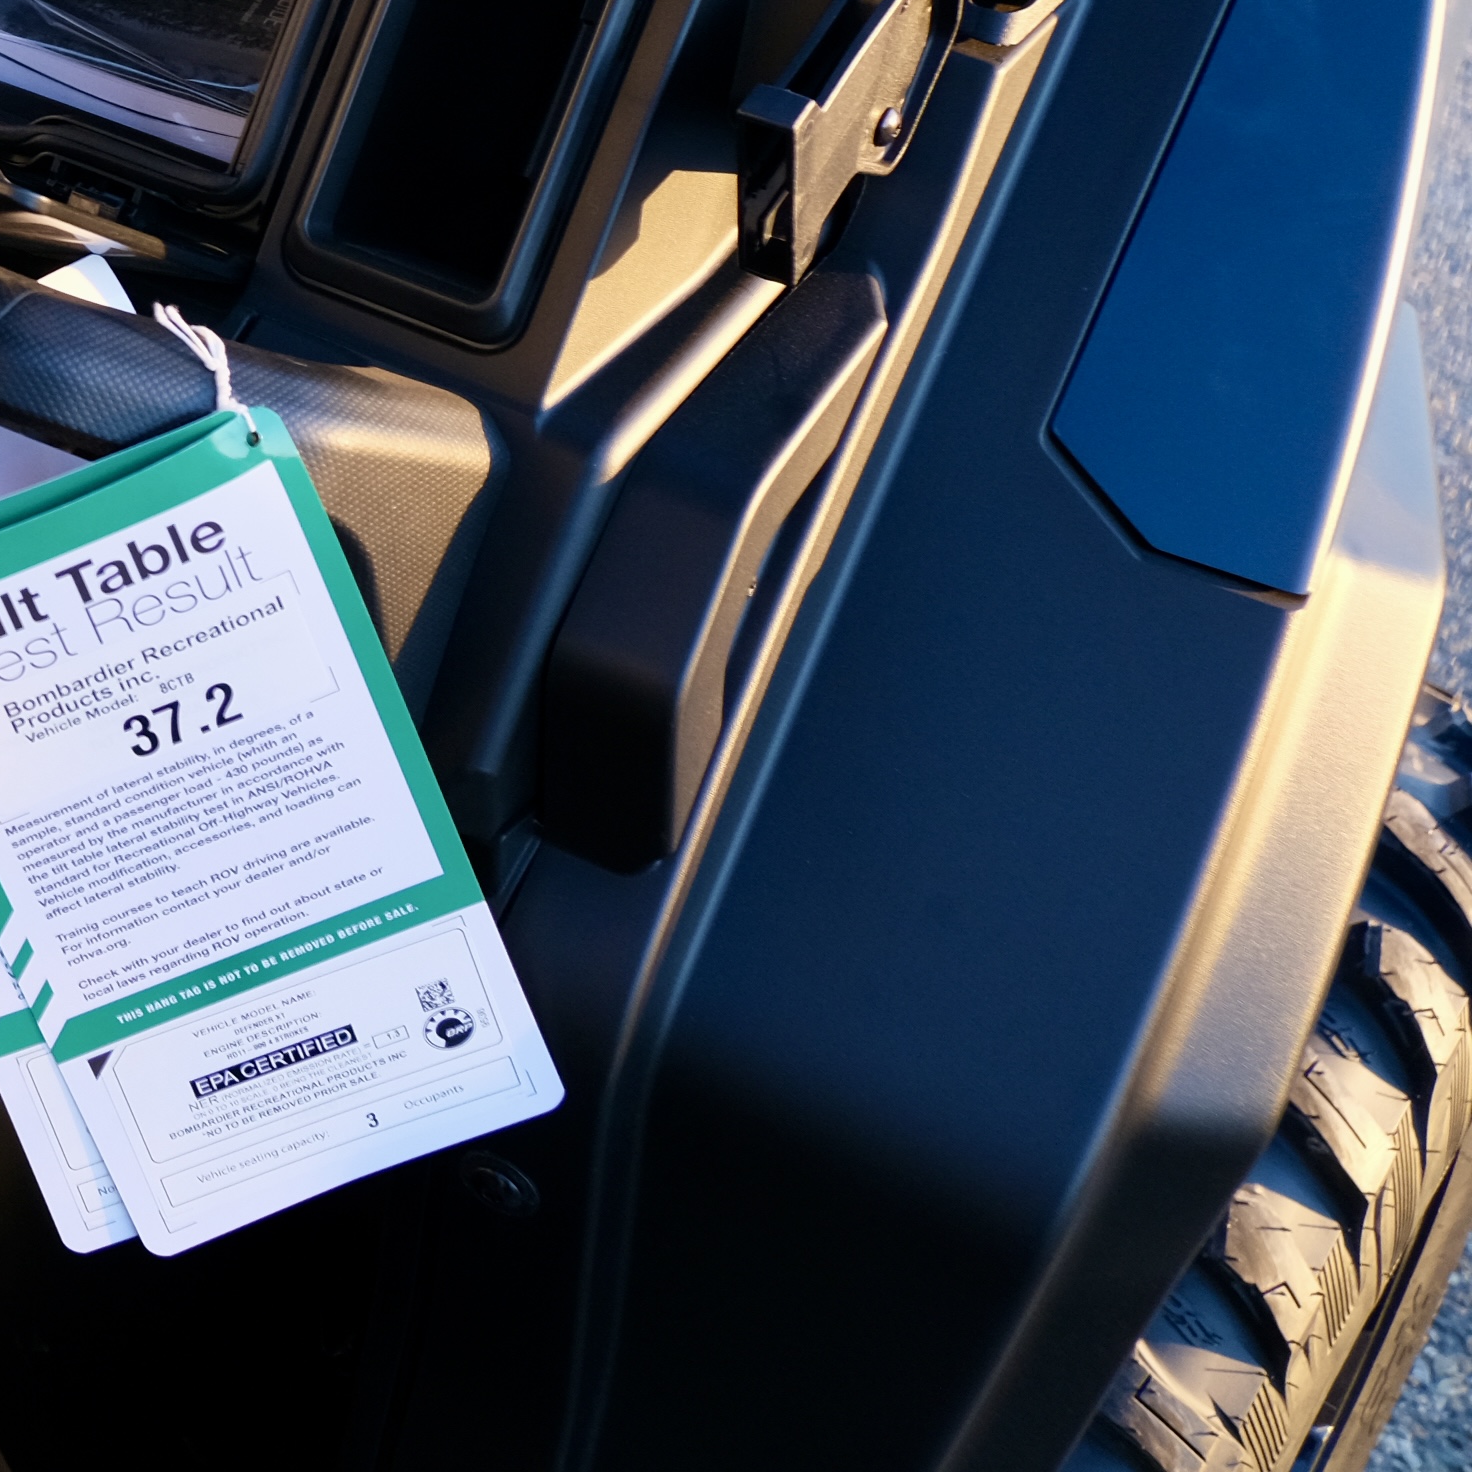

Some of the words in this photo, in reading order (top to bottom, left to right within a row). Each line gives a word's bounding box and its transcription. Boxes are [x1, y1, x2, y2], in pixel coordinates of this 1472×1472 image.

[54, 521, 228, 610] Table
[84, 546, 263, 645] Result
[3, 658, 134, 718] Bombardier
[141, 595, 284, 664] Recreational
[10, 687, 113, 734] Products
[117, 671, 160, 692] inc.
[25, 717, 81, 743] Vehicle
[85, 694, 138, 720] Model:
[159, 672, 195, 694] 8CTB
[123, 683, 243, 757] 37.2
[4, 796, 94, 837] Measurement
[96, 789, 109, 800] of
[111, 772, 154, 794] lateral
[156, 753, 211, 777] stability,
[212, 746, 226, 756] in
[229, 724, 286, 750] degrees,
[289, 713, 302, 726] of
[305, 711, 314, 719] a
[11, 826, 62, 849] sample,
[64, 798, 121, 827] standard
[124, 776, 185, 804] condition
[187, 757, 234, 779] vehicle
[281, 732, 297, 744] an
[17, 834, 71, 860] operator
[75, 822, 100, 838] and
[102, 819, 111, 827] a
[113, 792, 181, 824] passenger
[183, 778, 213, 795] load
[225, 764, 248, 778] 430
[251, 742, 305, 772] pounds)
[308, 736, 323, 747] as
[22, 841, 86, 873] measured
[87, 836, 104, 847] by
[107, 826, 128, 839] the
[131, 792, 217, 830] manufacturer
[220, 786, 234, 795] in
[237, 755, 313, 789] accordance
[316, 742, 345, 757] with
[28, 872, 49, 884] the
[51, 863, 69, 875] tilt
[71, 850, 103, 867] table
[105, 831, 147, 853] lateral
[150, 813, 200, 836] stability
[203, 800, 229, 816] test
[231, 796, 244, 805] in
[248, 760, 333, 800] ANSI/ROHVA
[34, 868, 91, 896] standard
[92, 861, 111, 873] for
[113, 827, 196, 865] Recreational
[198, 797, 278, 832] Off-Highway
[280, 774, 340, 799] Vehicles.
[38, 886, 85, 907] Vehicle
[88, 854, 172, 889] modification,
[174, 821, 256, 856] accessories,
[258, 807, 283, 823] and
[285, 789, 335, 813] loading
[337, 778, 362, 792] can
[55, 922, 99, 942] Trainig
[102, 901, 153, 925] courses
[155, 895, 169, 904] to
[171, 880, 208, 898] teach
[210, 865, 238, 883] ROV
[243, 849, 287, 871] driving
[290, 840, 311, 853] are
[314, 817, 375, 843] available.
[45, 900, 82, 920] affect
[83, 882, 125, 905] lateral
[127, 864, 180, 888] stability.
[61, 942, 82, 955] For
[85, 913, 159, 946] information
[162, 891, 211, 916] contact
[212, 880, 241, 898] your
[245, 864, 284, 884] dealer
[288, 846, 330, 867] and/or
[78, 969, 120, 989] Check
[121, 958, 149, 972] with
[151, 946, 179, 963] your
[183, 929, 222, 949] dealer
[225, 923, 239, 933] to
[241, 910, 267, 926] find
[269, 901, 292, 915] out
[294, 886, 332, 906] about
[334, 874, 366, 891] state
[369, 867, 383, 877] or
[67, 939, 131, 967] rohva.org.
[83, 983, 114, 1001] local
[116, 973, 146, 989] laws
[149, 948, 210, 976] regarding
[211, 934, 239, 952] ROV
[244, 911, 309, 939] operation.
[116, 1008, 144, 1024] THIS
[145, 995, 178, 1013] HANG
[178, 985, 202, 1000] TAG
[203, 979, 217, 991] IS
[218, 969, 241, 985] NOT
[243, 963, 259, 975] TO
[261, 956, 278, 969] BE
[279, 934, 335, 961] REMOVED
[336, 916, 383, 939] BEFORE
[384, 903, 419, 921] SALE.
[192, 1017, 236, 1038] VEHICLE
[240, 1004, 277, 1020] MODEL
[281, 991, 314, 1006] NAME:
[194, 1070, 242, 1099] EPA
[240, 1025, 356, 1083] CERTIFIED
[203, 1039, 243, 1058] ENGINE
[246, 1012, 323, 1043] DESCRIPTION:
[169, 1109, 241, 1140] BOMBARDIER
[242, 1080, 325, 1114] RECREATIONAL
[326, 1058, 386, 1084] PRODUCTS
[388, 1051, 407, 1062] INC
[188, 1095, 219, 1113] NER
[196, 1165, 236, 1183] Vehicle
[239, 1149, 279, 1168] seating
[281, 1131, 330, 1153] capacity:
[366, 1112, 379, 1128] 3
[404, 1085, 464, 1109] Occupants
[225, 1121, 239, 1131] TO
[241, 1115, 254, 1125] BE
[258, 1095, 311, 1119] REMOVED
[313, 1082, 348, 1099] PRIOR
